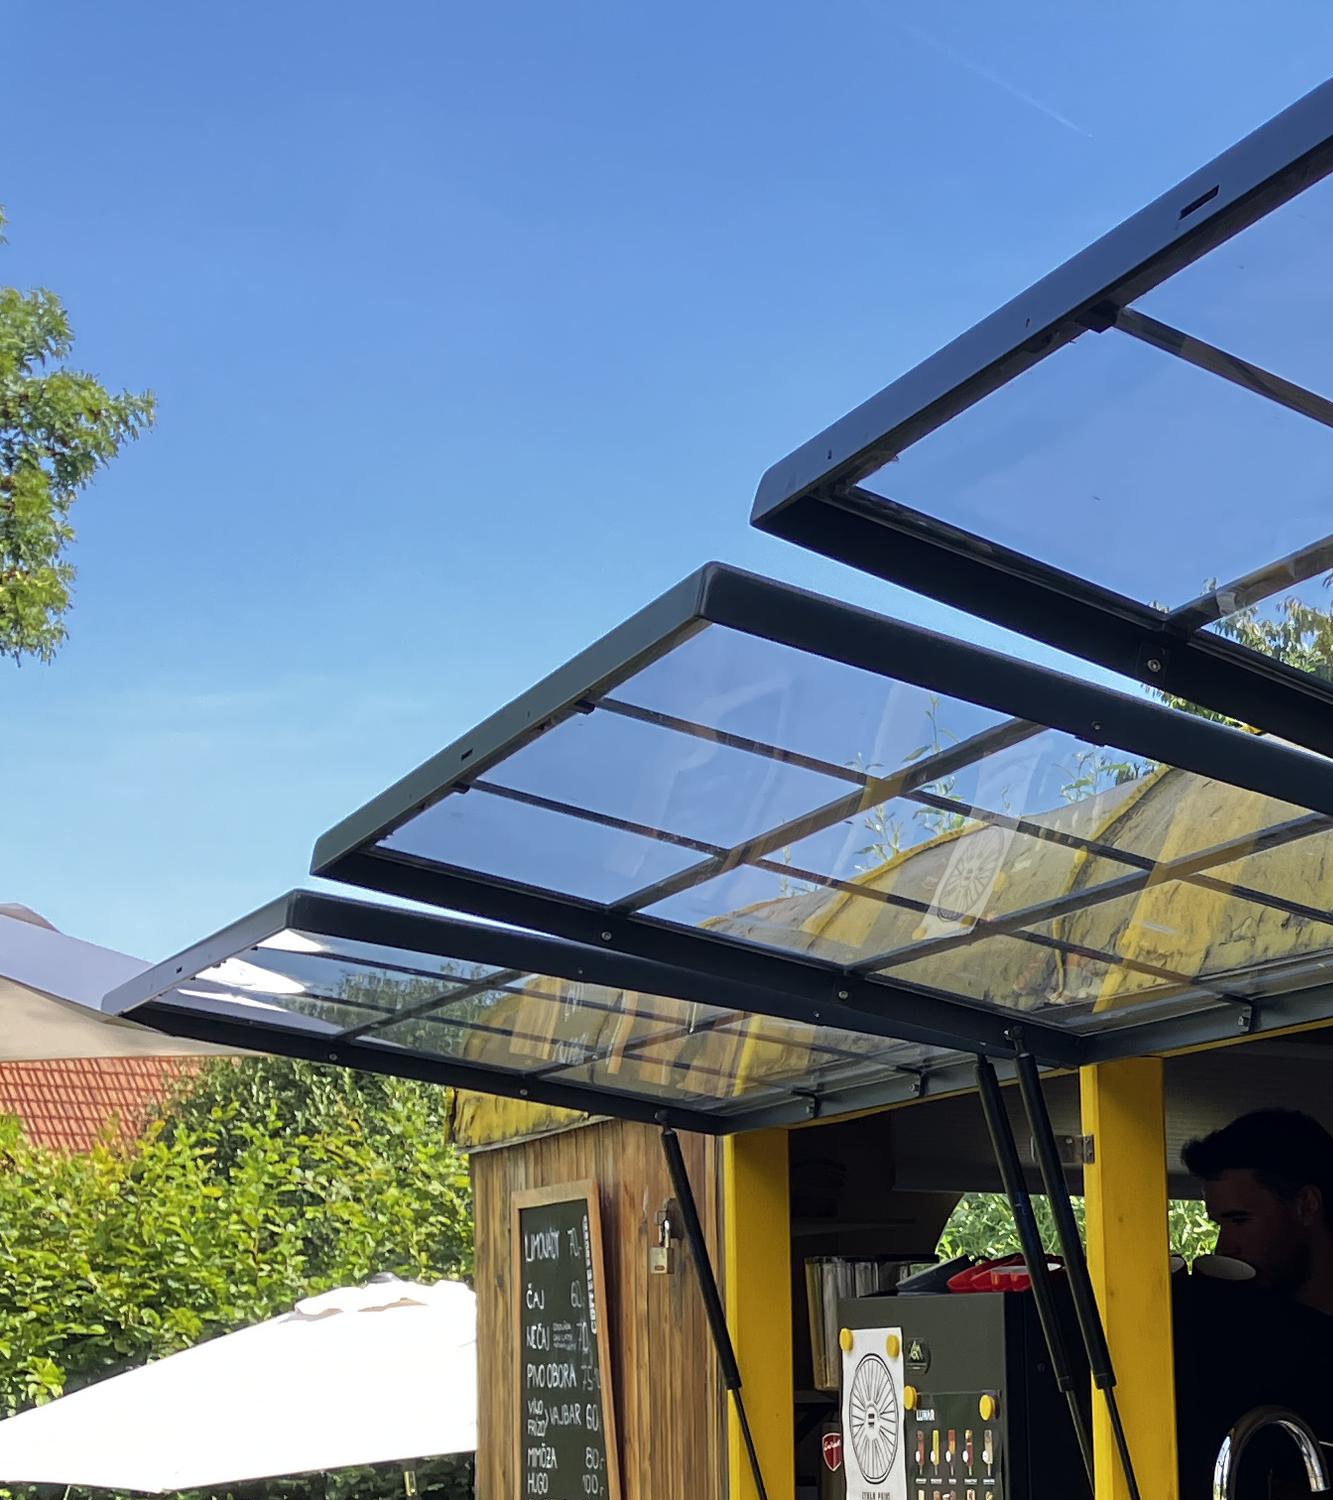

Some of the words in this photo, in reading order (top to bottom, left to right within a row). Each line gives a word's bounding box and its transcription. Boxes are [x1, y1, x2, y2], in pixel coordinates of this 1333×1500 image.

[526, 1282, 544, 1310] ČAJ
[546, 1363, 577, 1388] OBORA
[527, 1472, 549, 1495] HUGO
